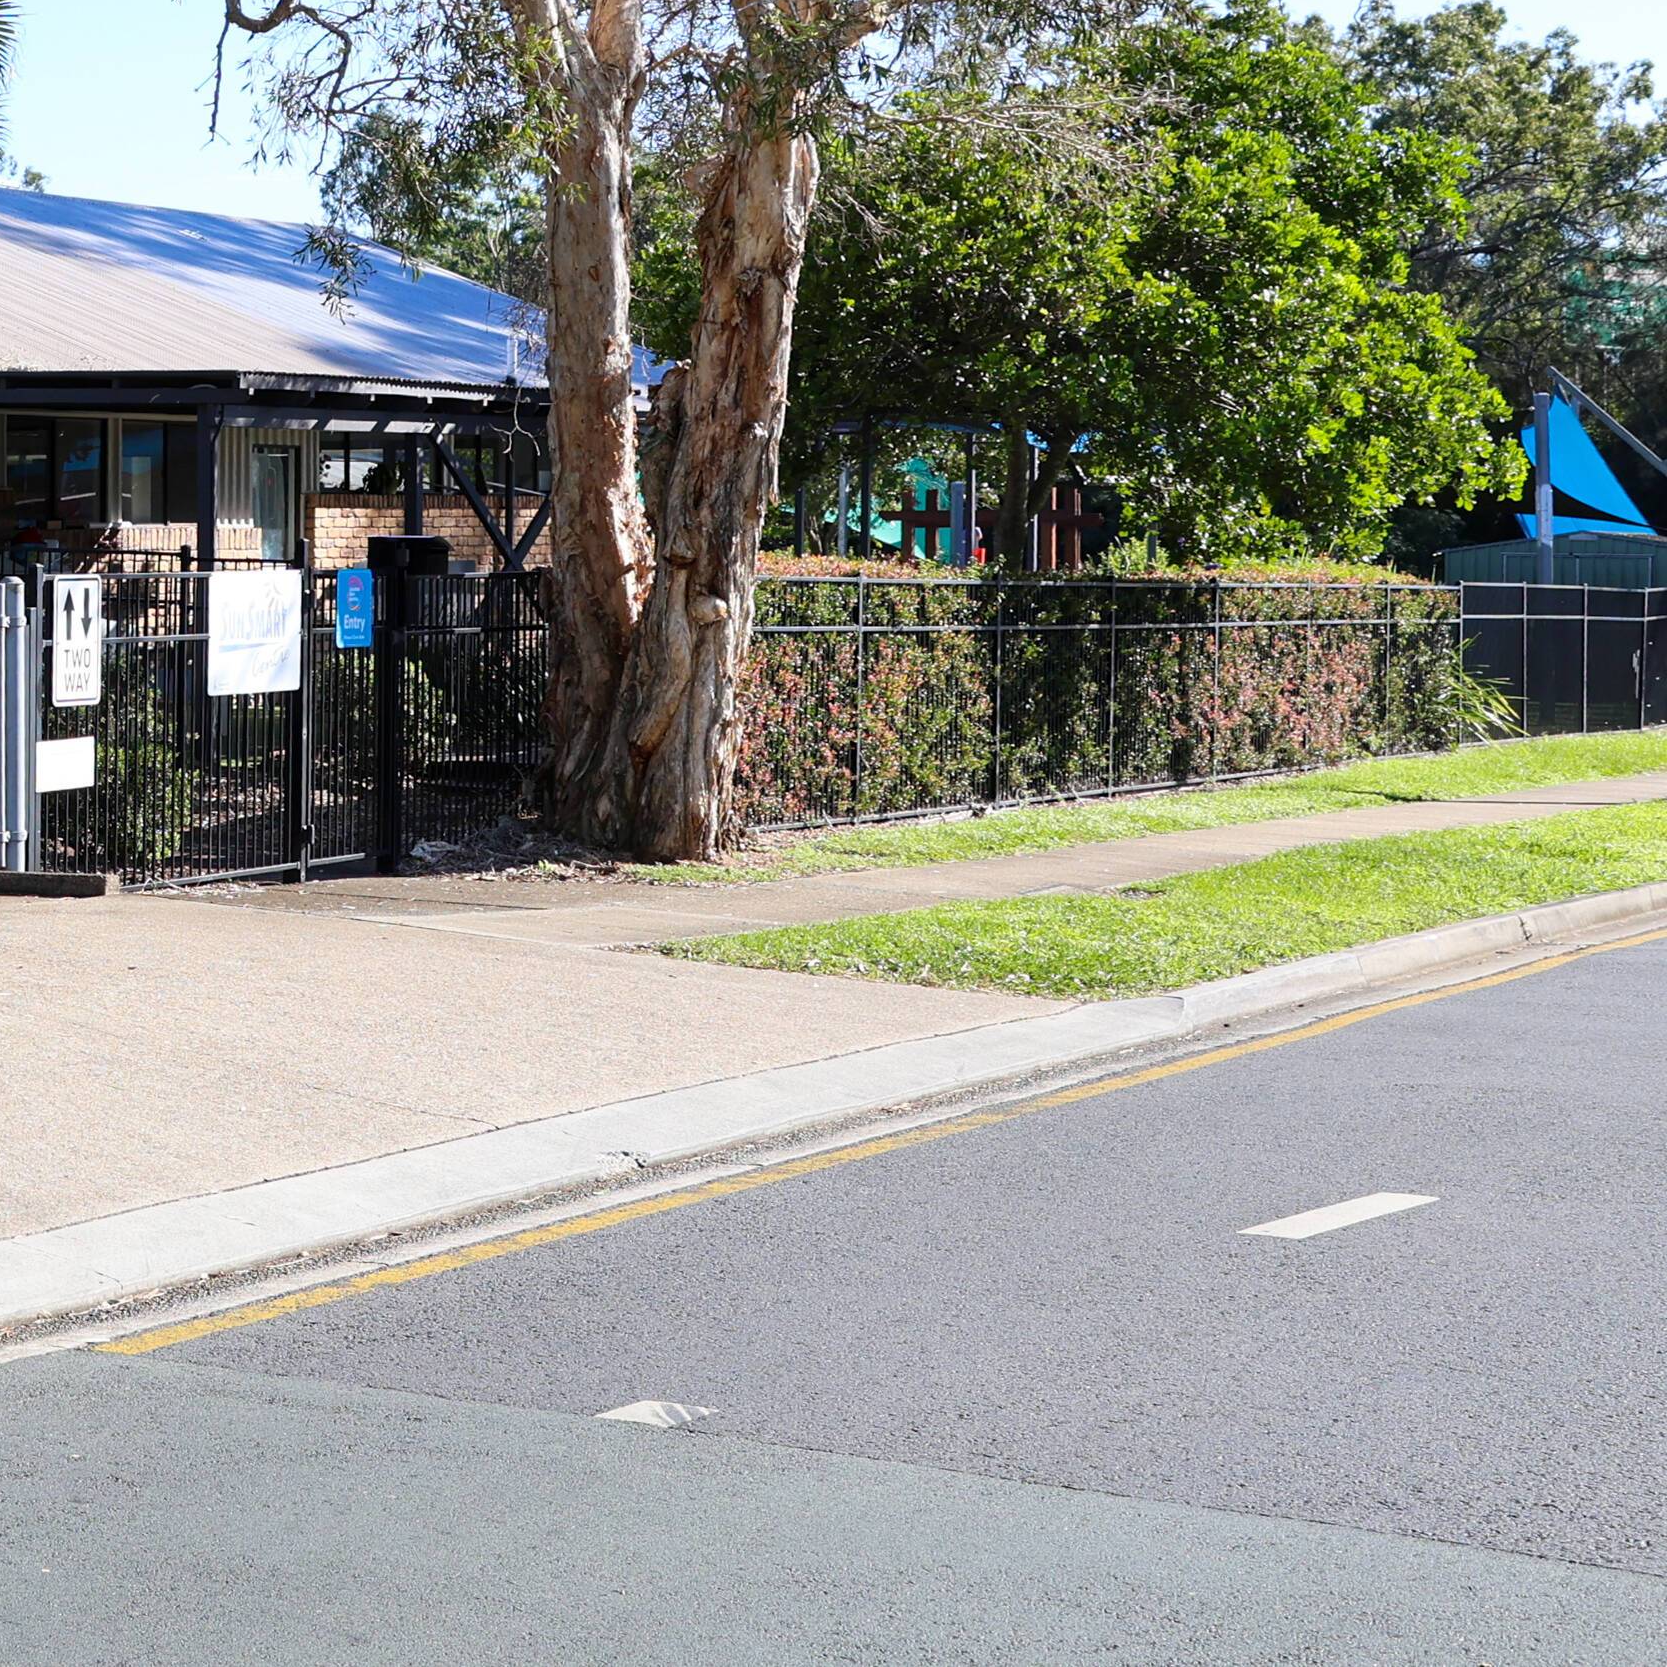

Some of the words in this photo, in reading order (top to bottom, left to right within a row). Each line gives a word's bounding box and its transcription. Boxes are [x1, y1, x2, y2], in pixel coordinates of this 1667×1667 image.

[344, 615, 366, 633] Entry
[64, 648, 91, 668] TWO
[64, 673, 91, 692] WAY
